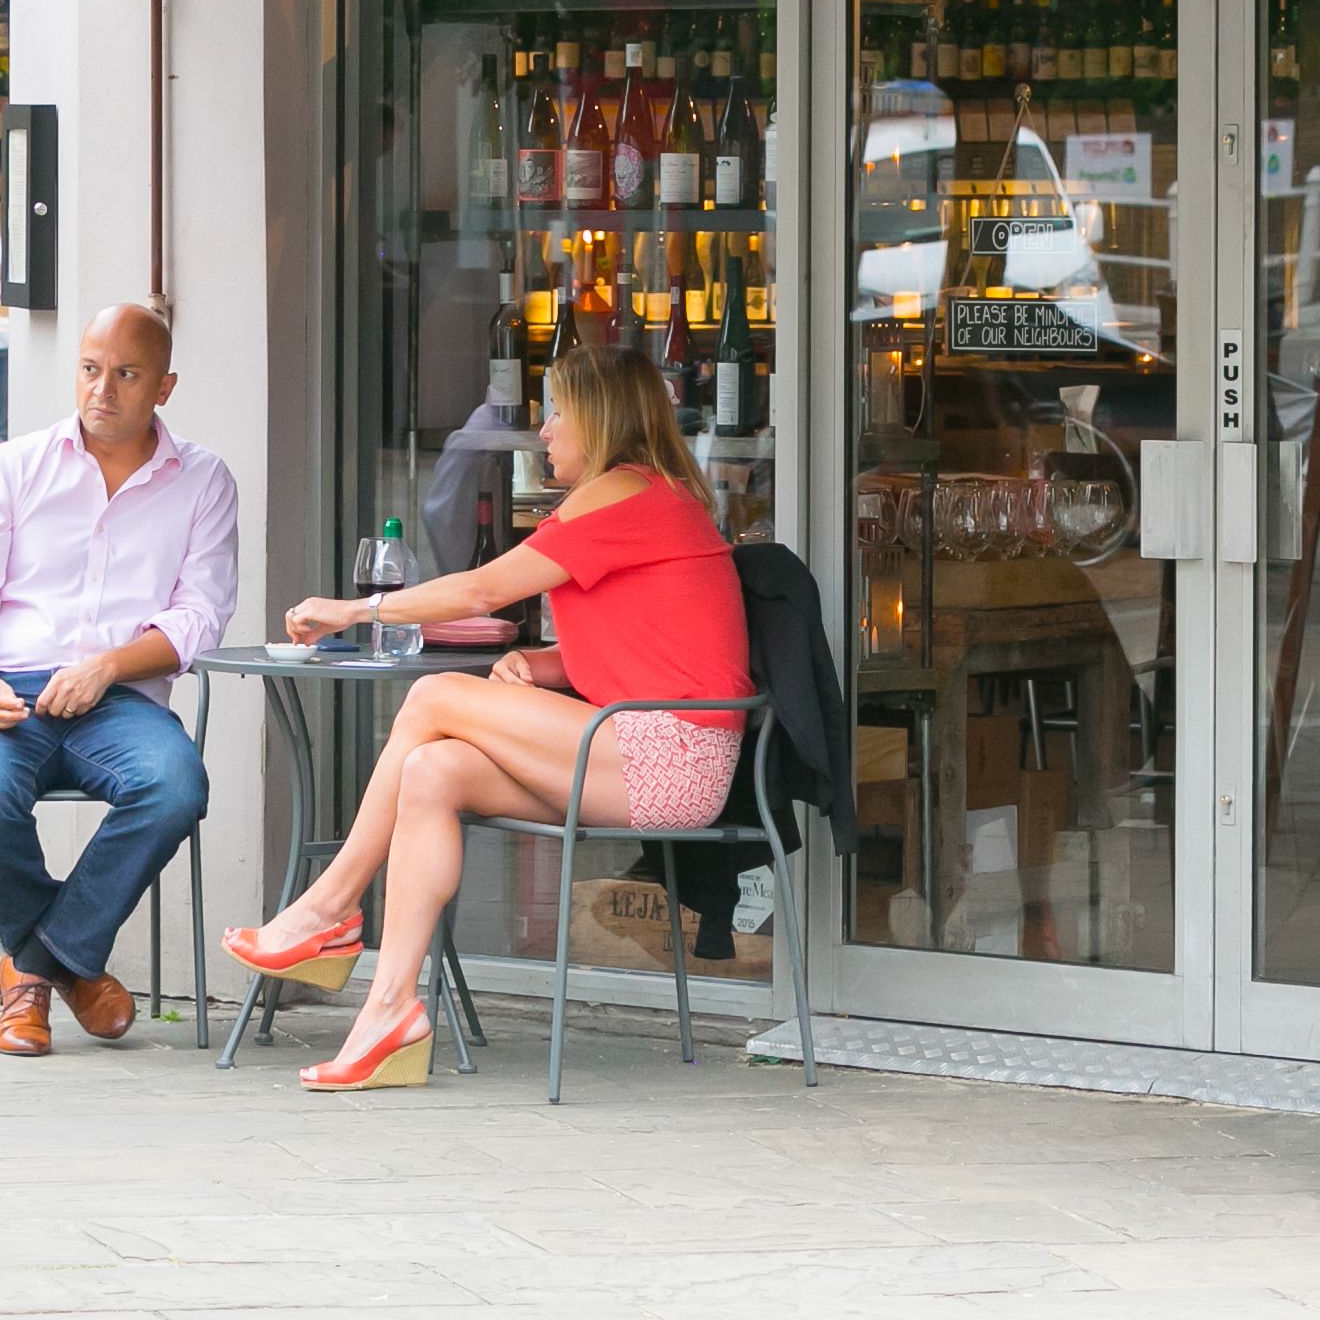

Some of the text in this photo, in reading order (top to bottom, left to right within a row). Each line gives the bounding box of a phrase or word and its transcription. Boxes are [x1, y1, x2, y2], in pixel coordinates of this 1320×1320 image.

[992, 222, 1053, 250] OPEN
[957, 305, 1093, 327] PLEASE BE MINDFUL
[957, 327, 1093, 347] OF OUR NEIGHBOURS
[1223, 342, 1239, 428] PUSH
